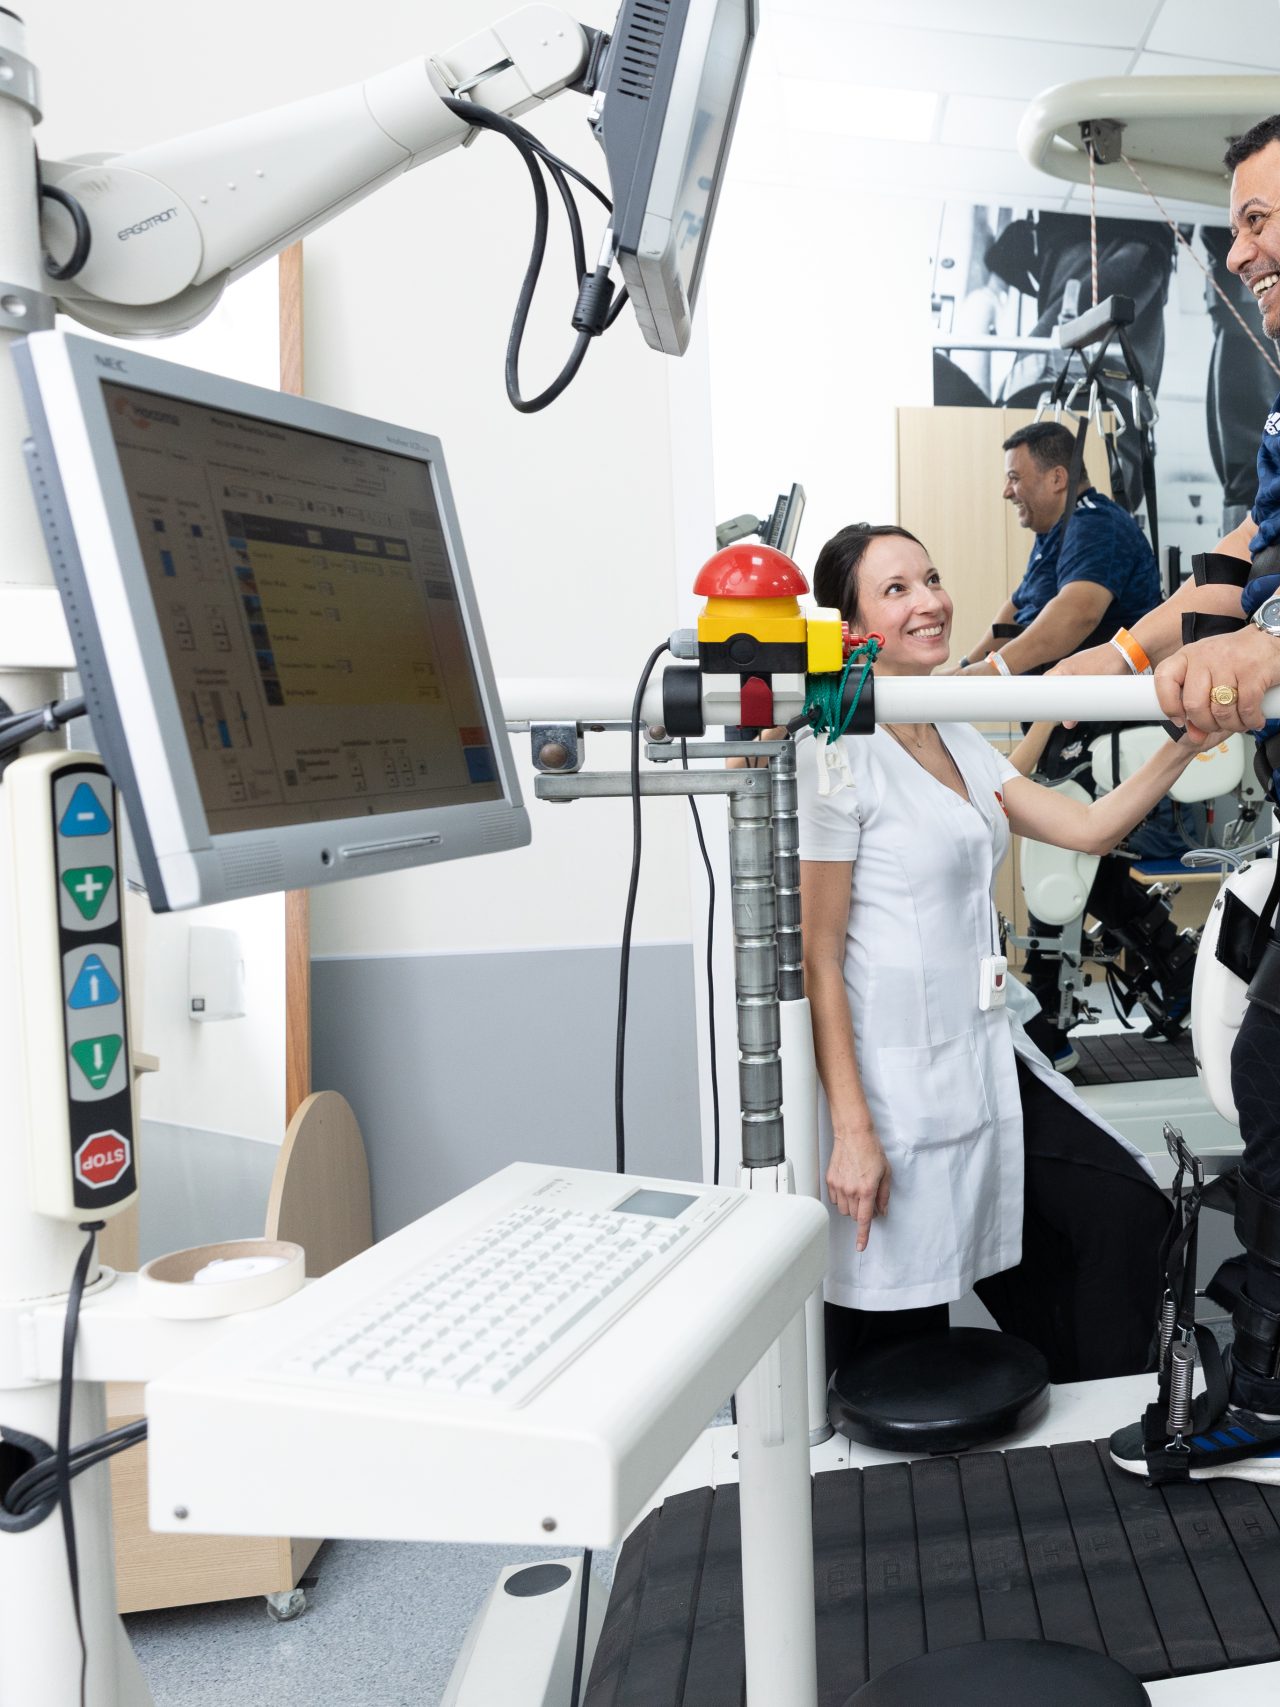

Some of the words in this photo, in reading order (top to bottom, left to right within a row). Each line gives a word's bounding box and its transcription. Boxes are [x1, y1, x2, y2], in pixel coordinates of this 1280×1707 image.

[117, 208, 178, 241] ERGOTRON
[94, 354, 128, 373] NEC
[82, 1148, 124, 1170] STOP
